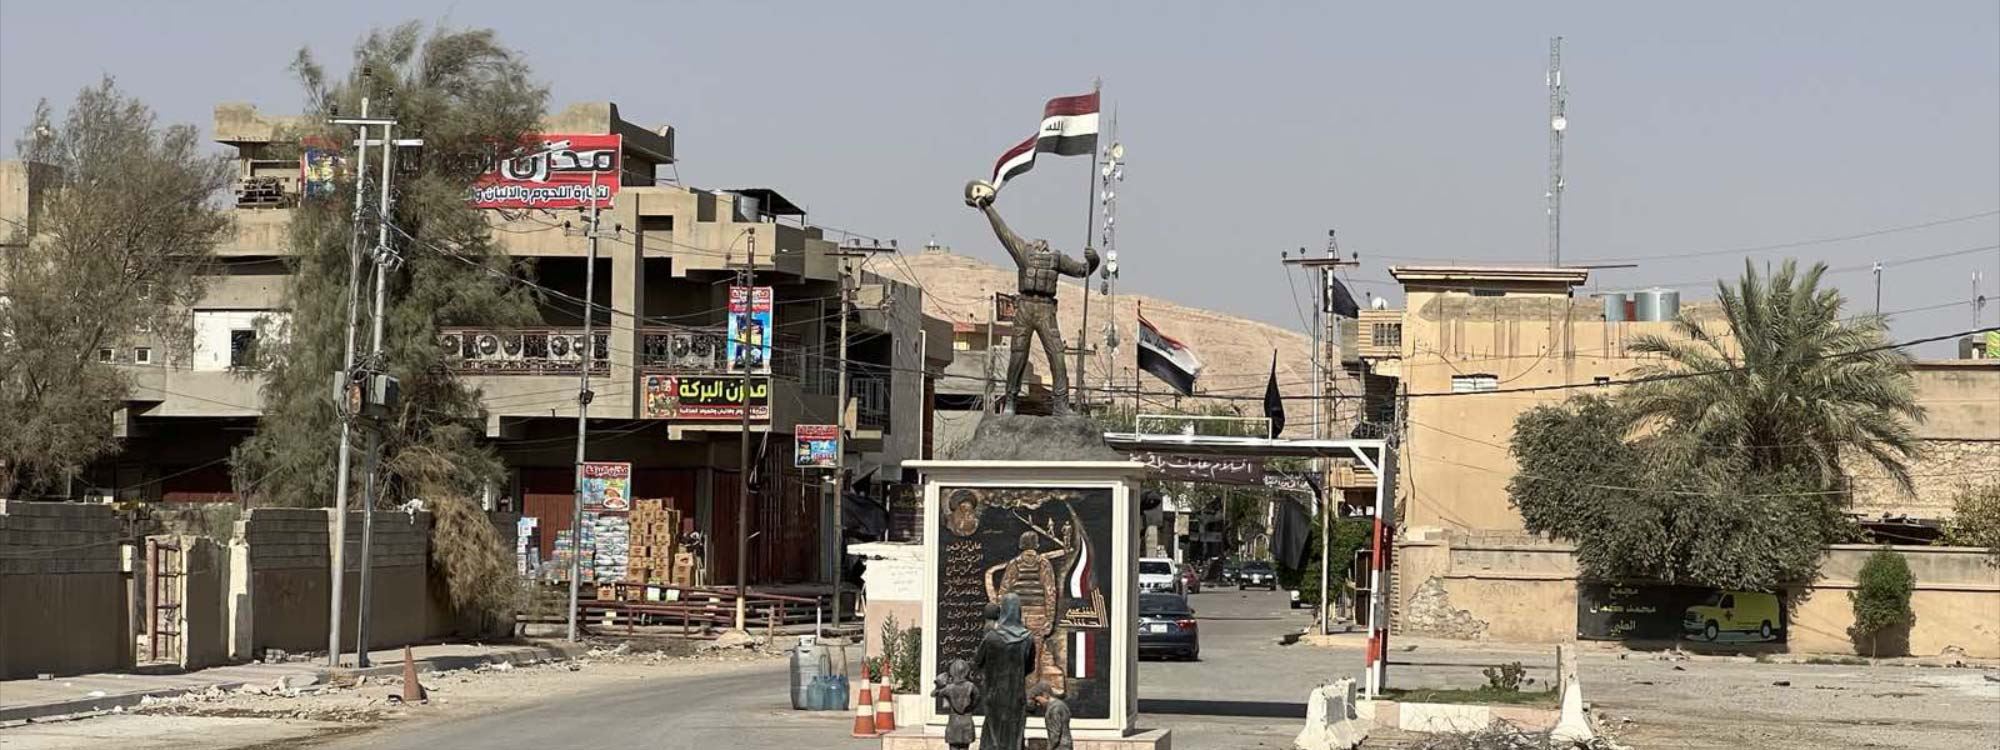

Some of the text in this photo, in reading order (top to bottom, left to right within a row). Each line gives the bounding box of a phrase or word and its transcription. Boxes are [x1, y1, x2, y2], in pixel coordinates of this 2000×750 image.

[679, 379, 723, 402] البركة
[1210, 458, 1251, 480] السلام
[1626, 605, 1656, 613] محمد
